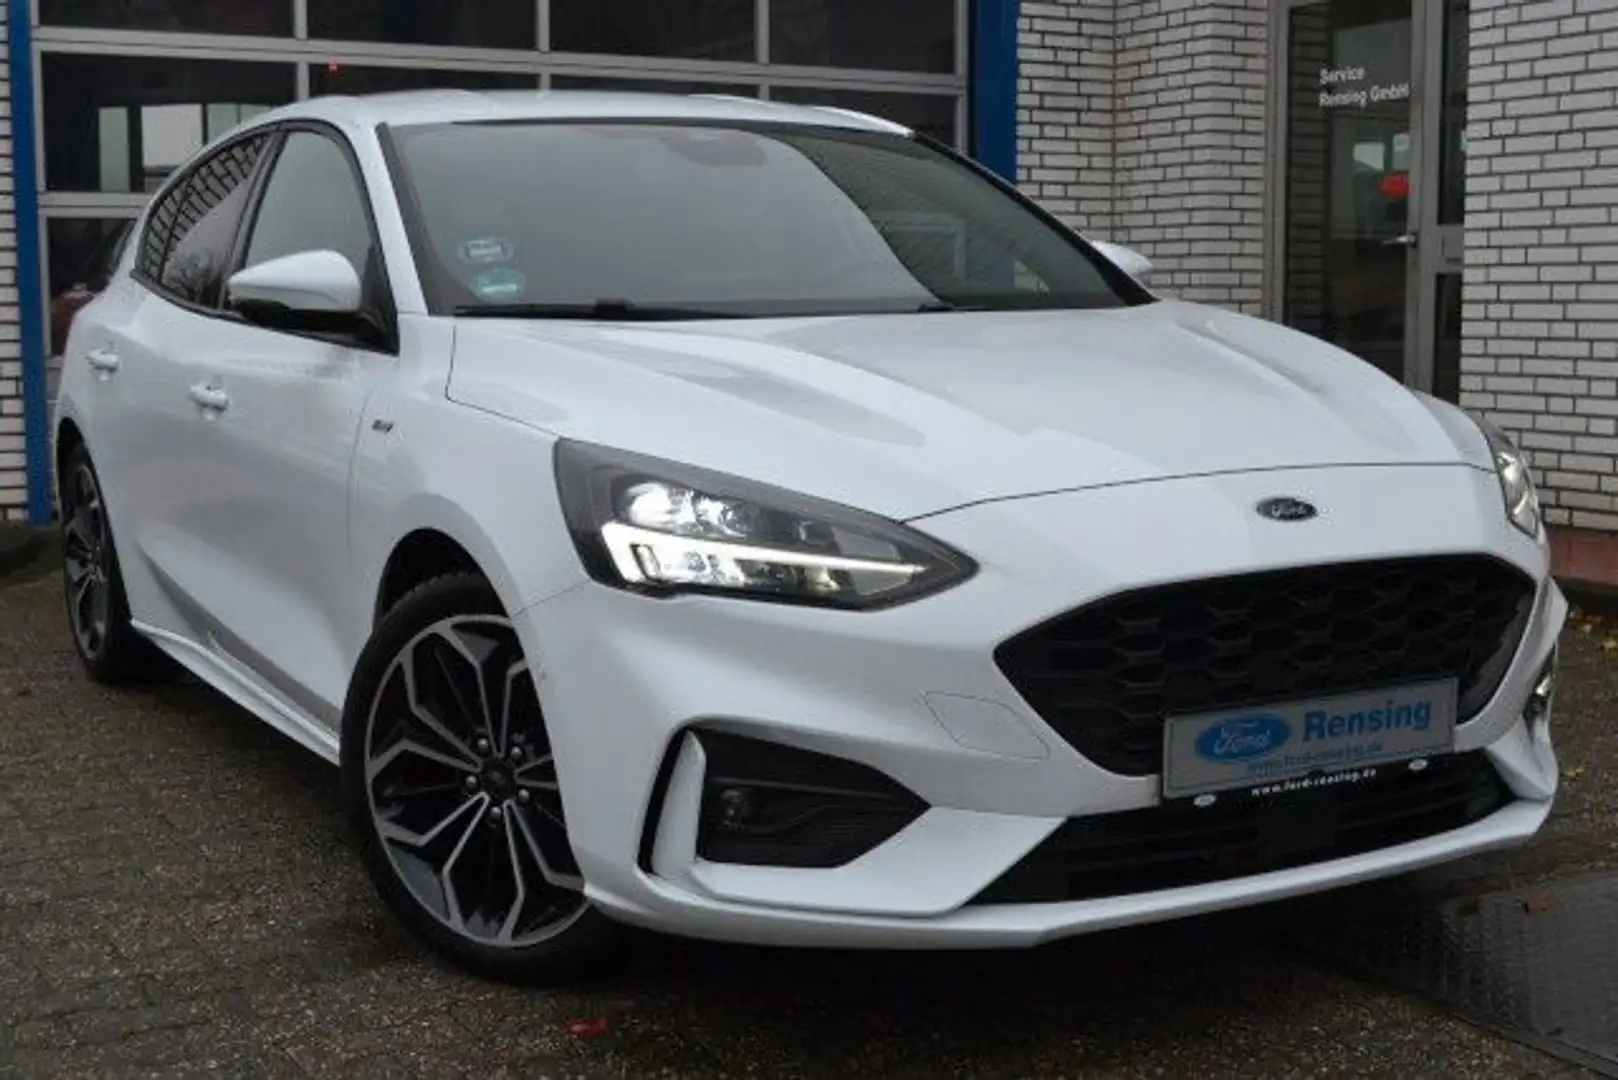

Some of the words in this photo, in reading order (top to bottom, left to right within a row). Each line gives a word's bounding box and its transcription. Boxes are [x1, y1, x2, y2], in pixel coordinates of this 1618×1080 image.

[1319, 67, 1365, 84] Service
[1319, 90, 1368, 108] Rensing
[1370, 83, 1410, 101] GmbH
[1212, 721, 1273, 755] Ford
[1302, 699, 1433, 742] Rensing
